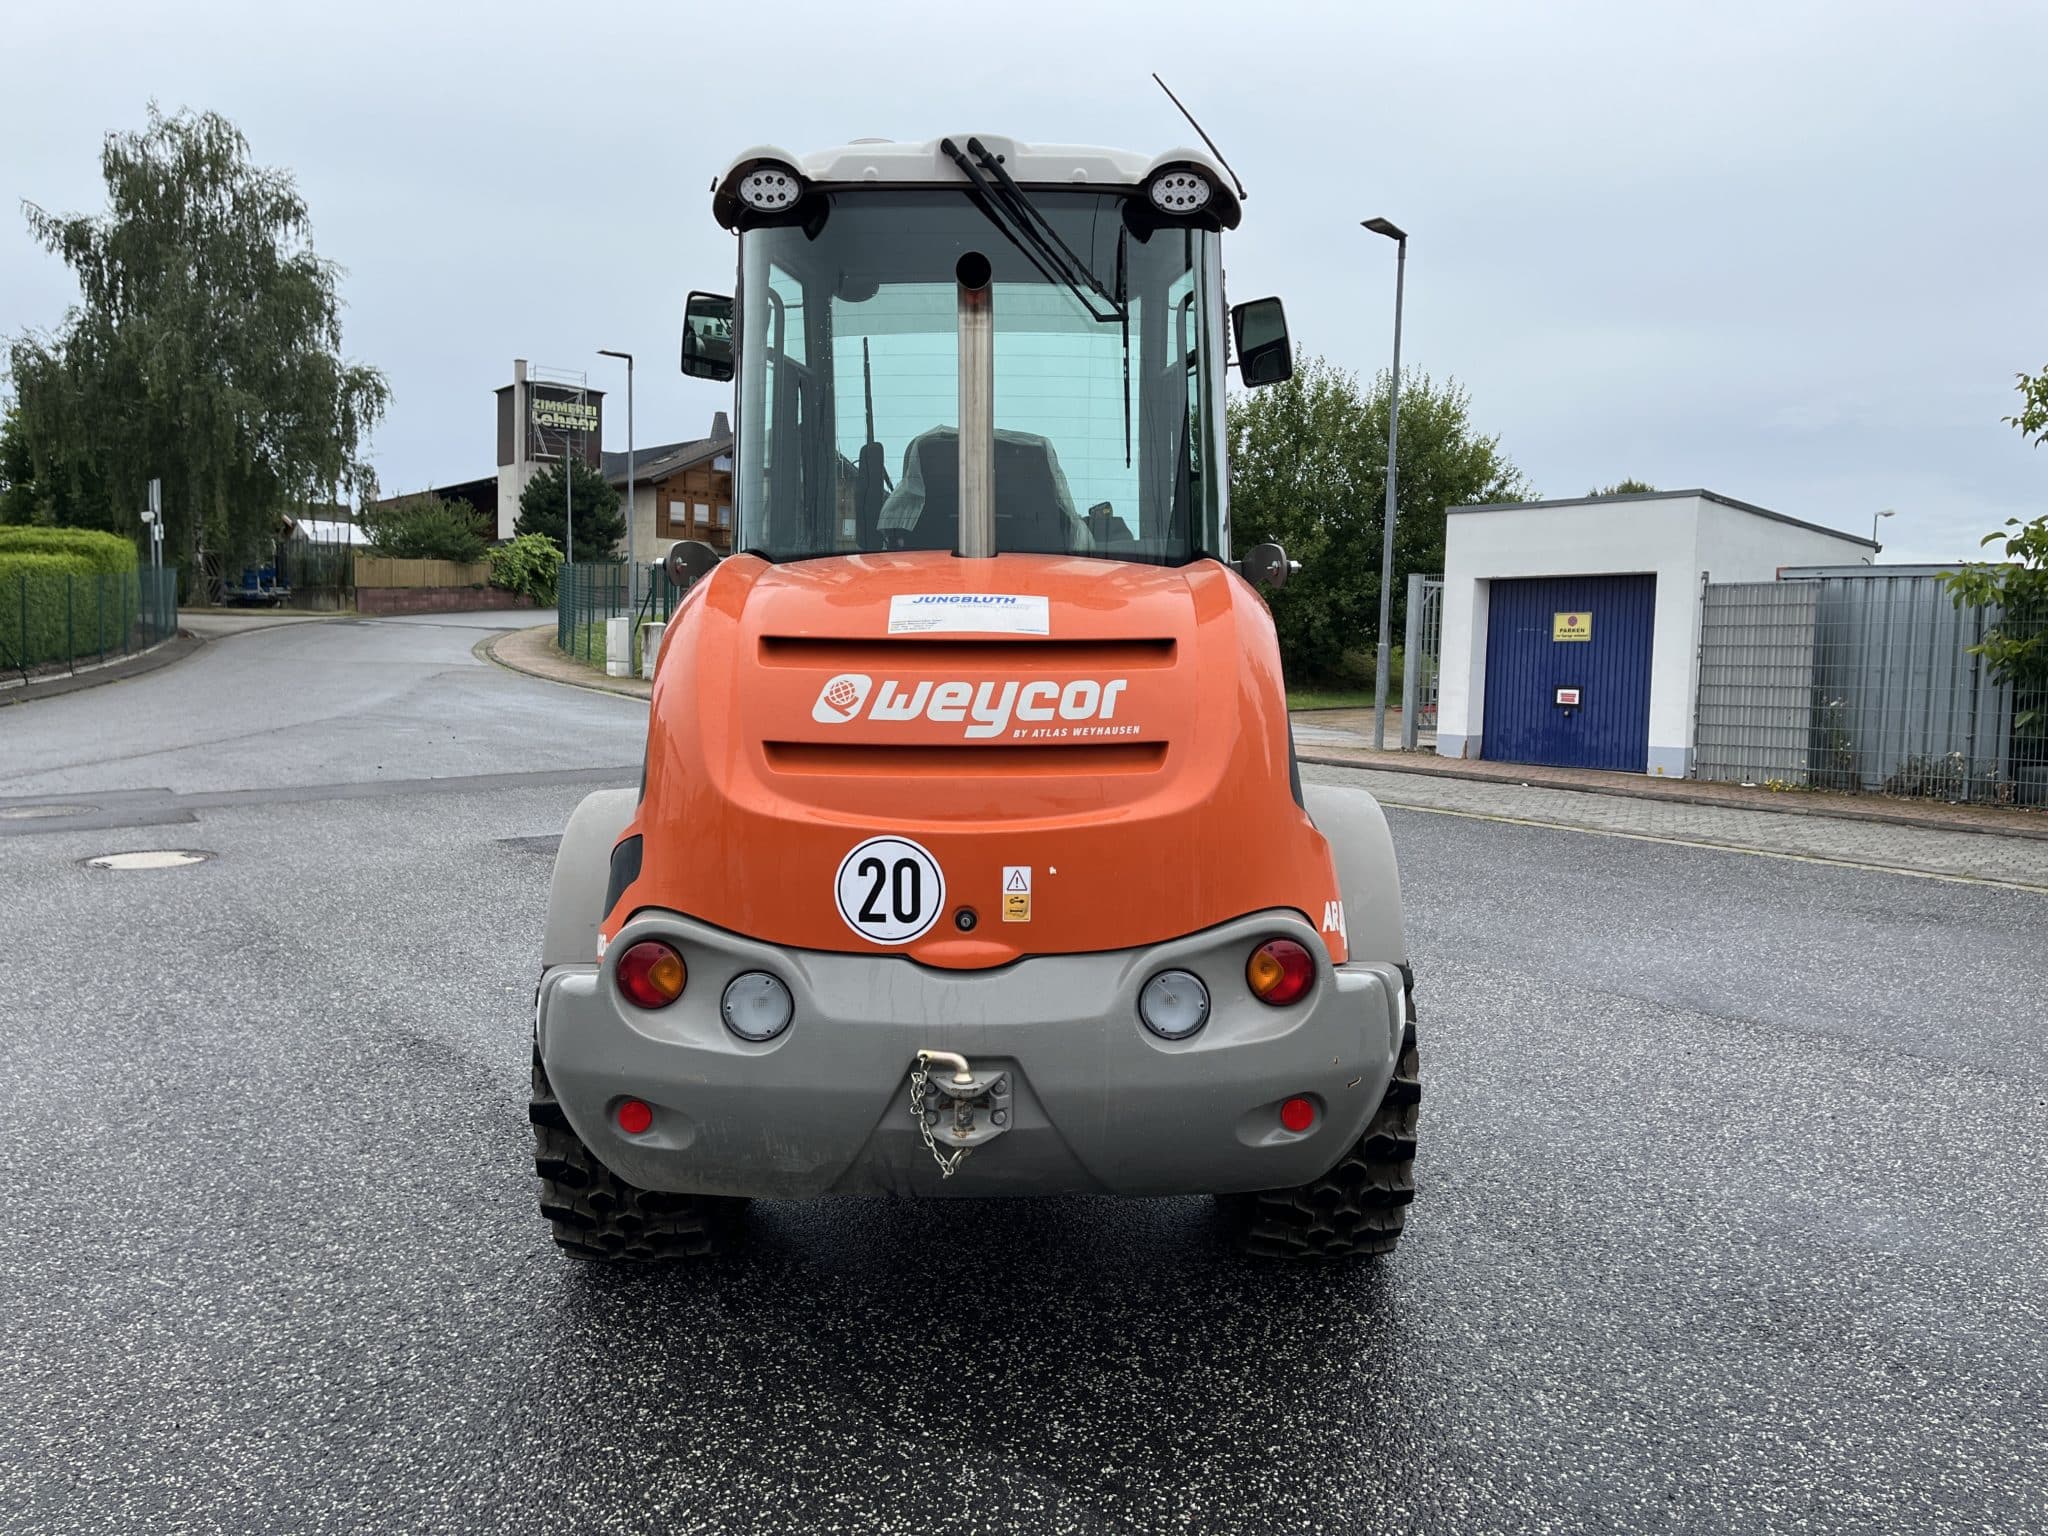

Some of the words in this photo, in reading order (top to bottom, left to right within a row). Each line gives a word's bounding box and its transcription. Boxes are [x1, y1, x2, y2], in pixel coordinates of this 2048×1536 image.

[532, 398, 597, 417] ZIMMEREI
[532, 410, 598, 432] Lehner
[912, 596, 1017, 604] JUNGBLUTH
[868, 679, 1127, 739] weycor
[1013, 729, 1027, 738] BY
[1032, 728, 1068, 738] ATLAS
[1072, 725, 1140, 736] WEYHAUSEN
[858, 857, 921, 924] 20
